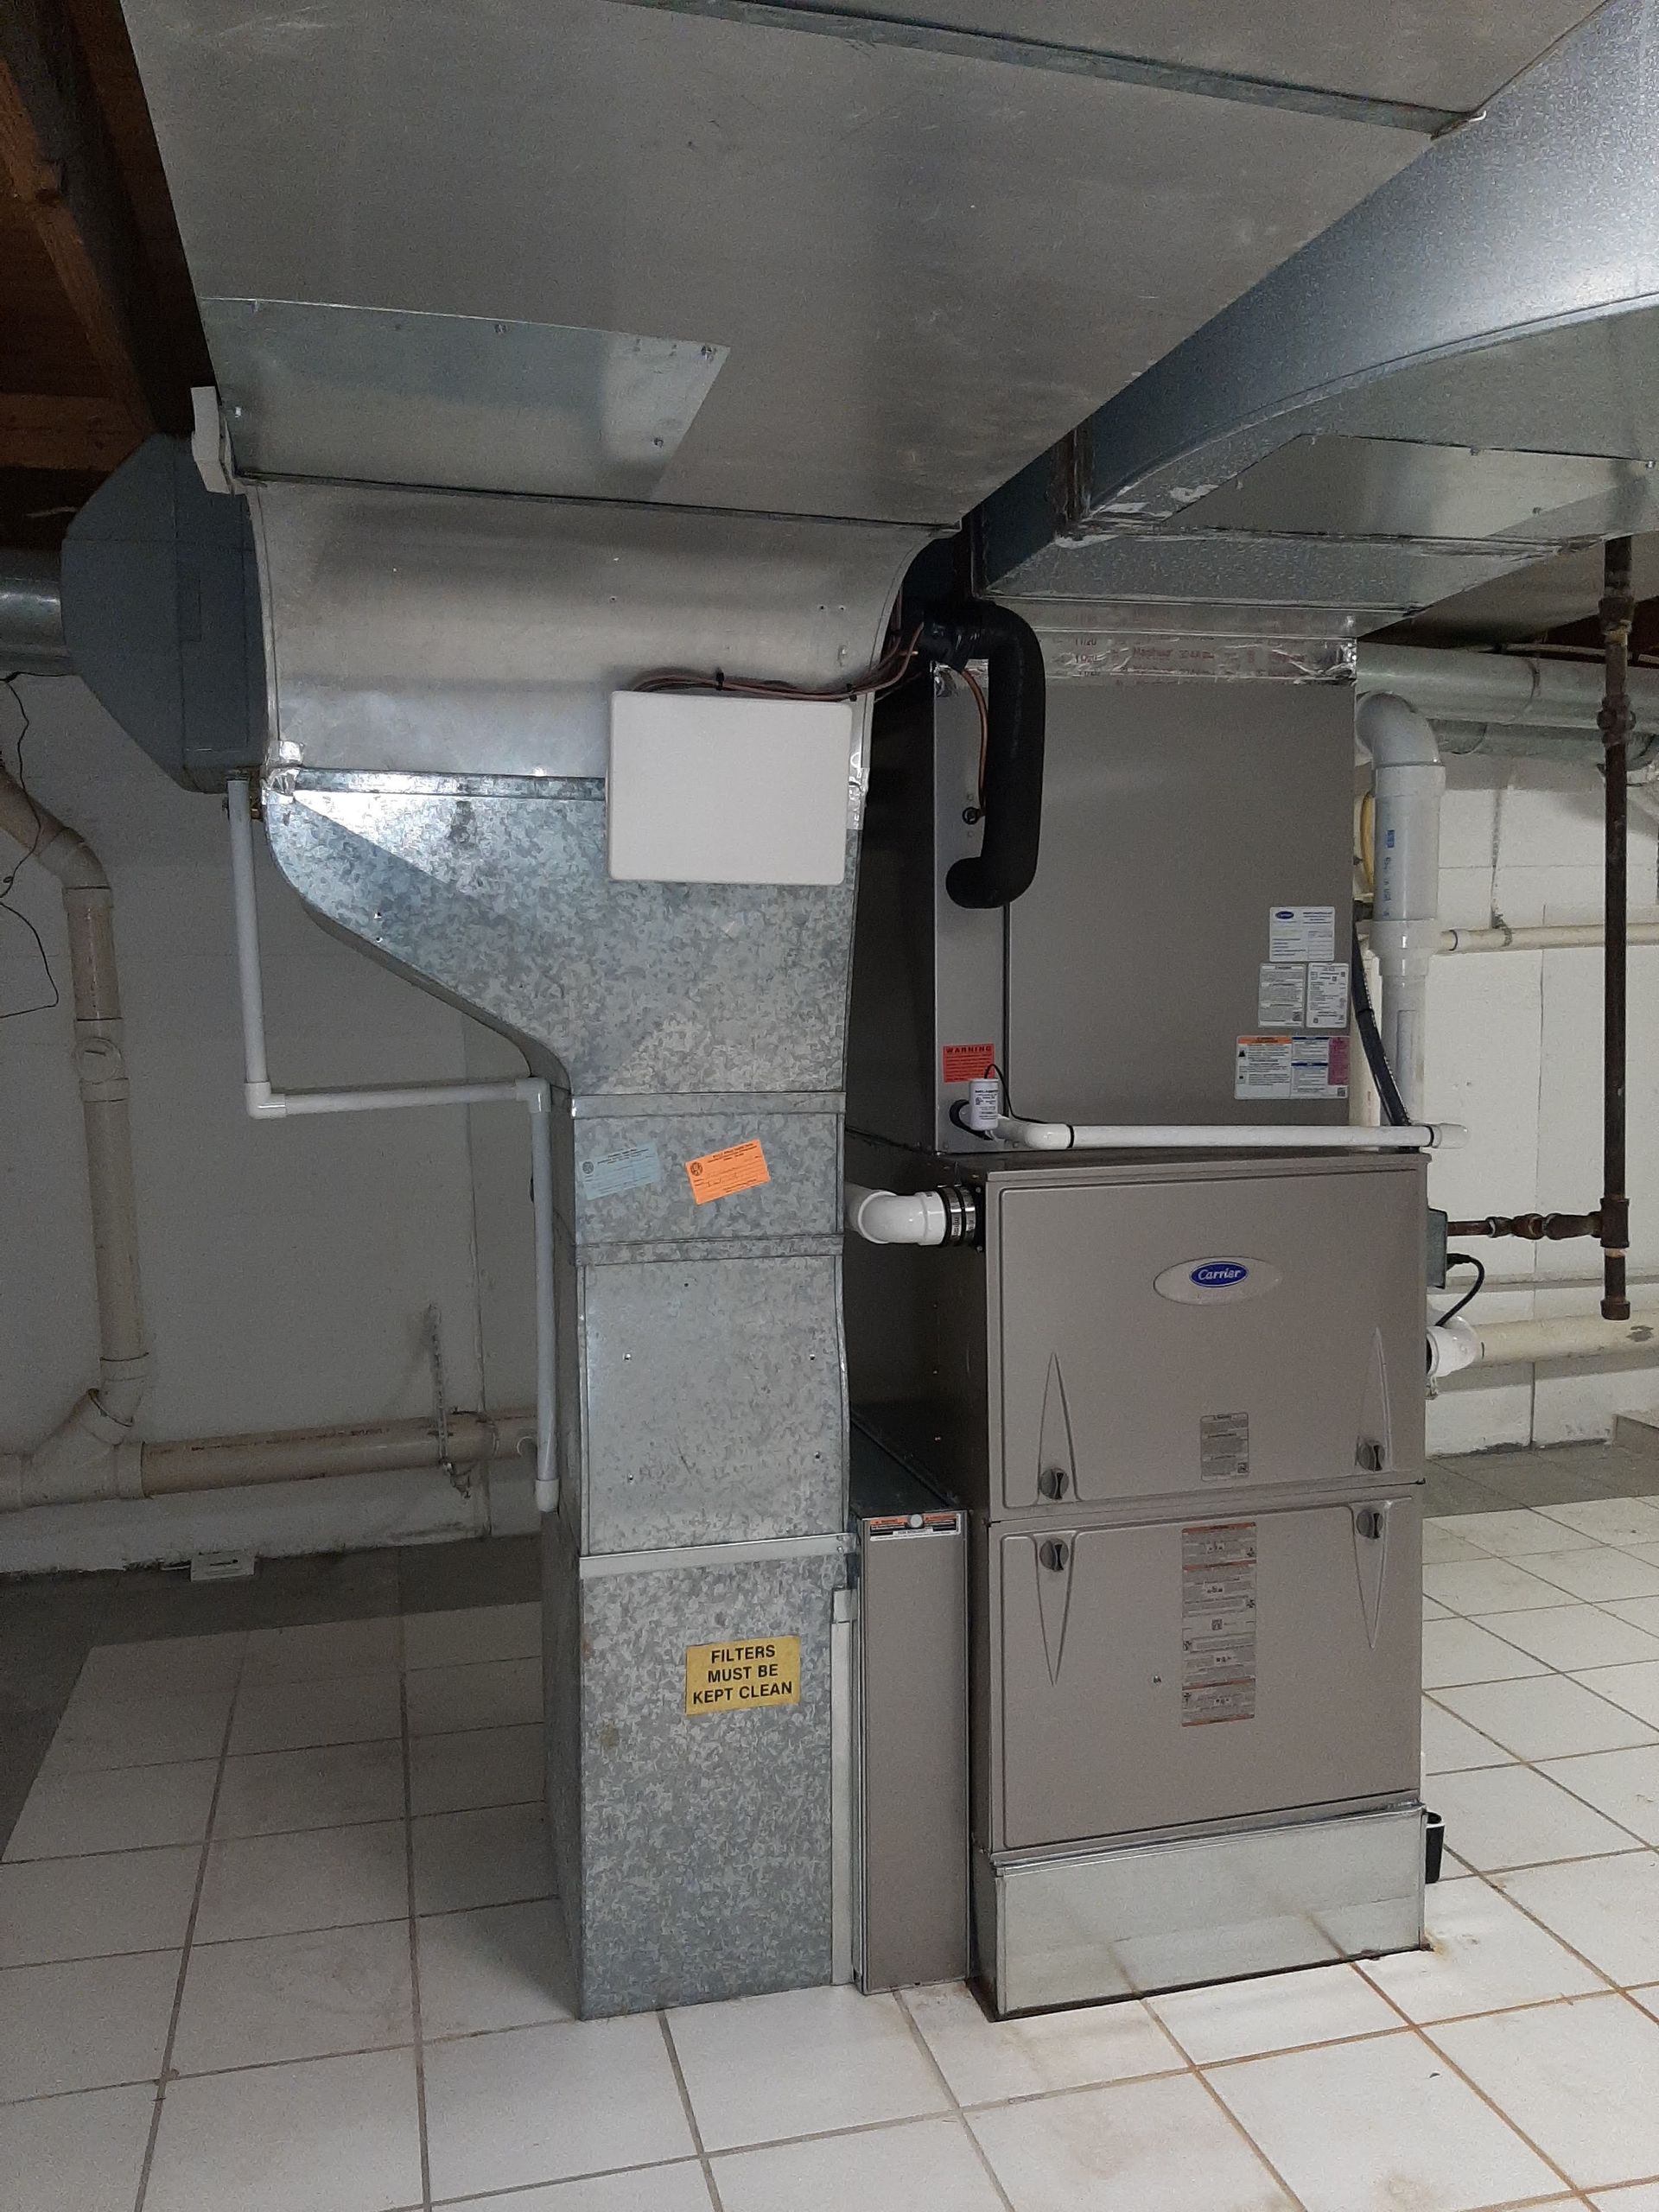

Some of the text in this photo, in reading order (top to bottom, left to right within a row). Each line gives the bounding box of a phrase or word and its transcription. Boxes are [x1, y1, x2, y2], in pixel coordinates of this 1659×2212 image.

[1198, 1268, 1242, 1281] Carrier
[711, 1644, 776, 1664] FILTERS
[708, 1663, 779, 1683] MUST BE
[693, 1681, 792, 1705] KEPT CLEAN
